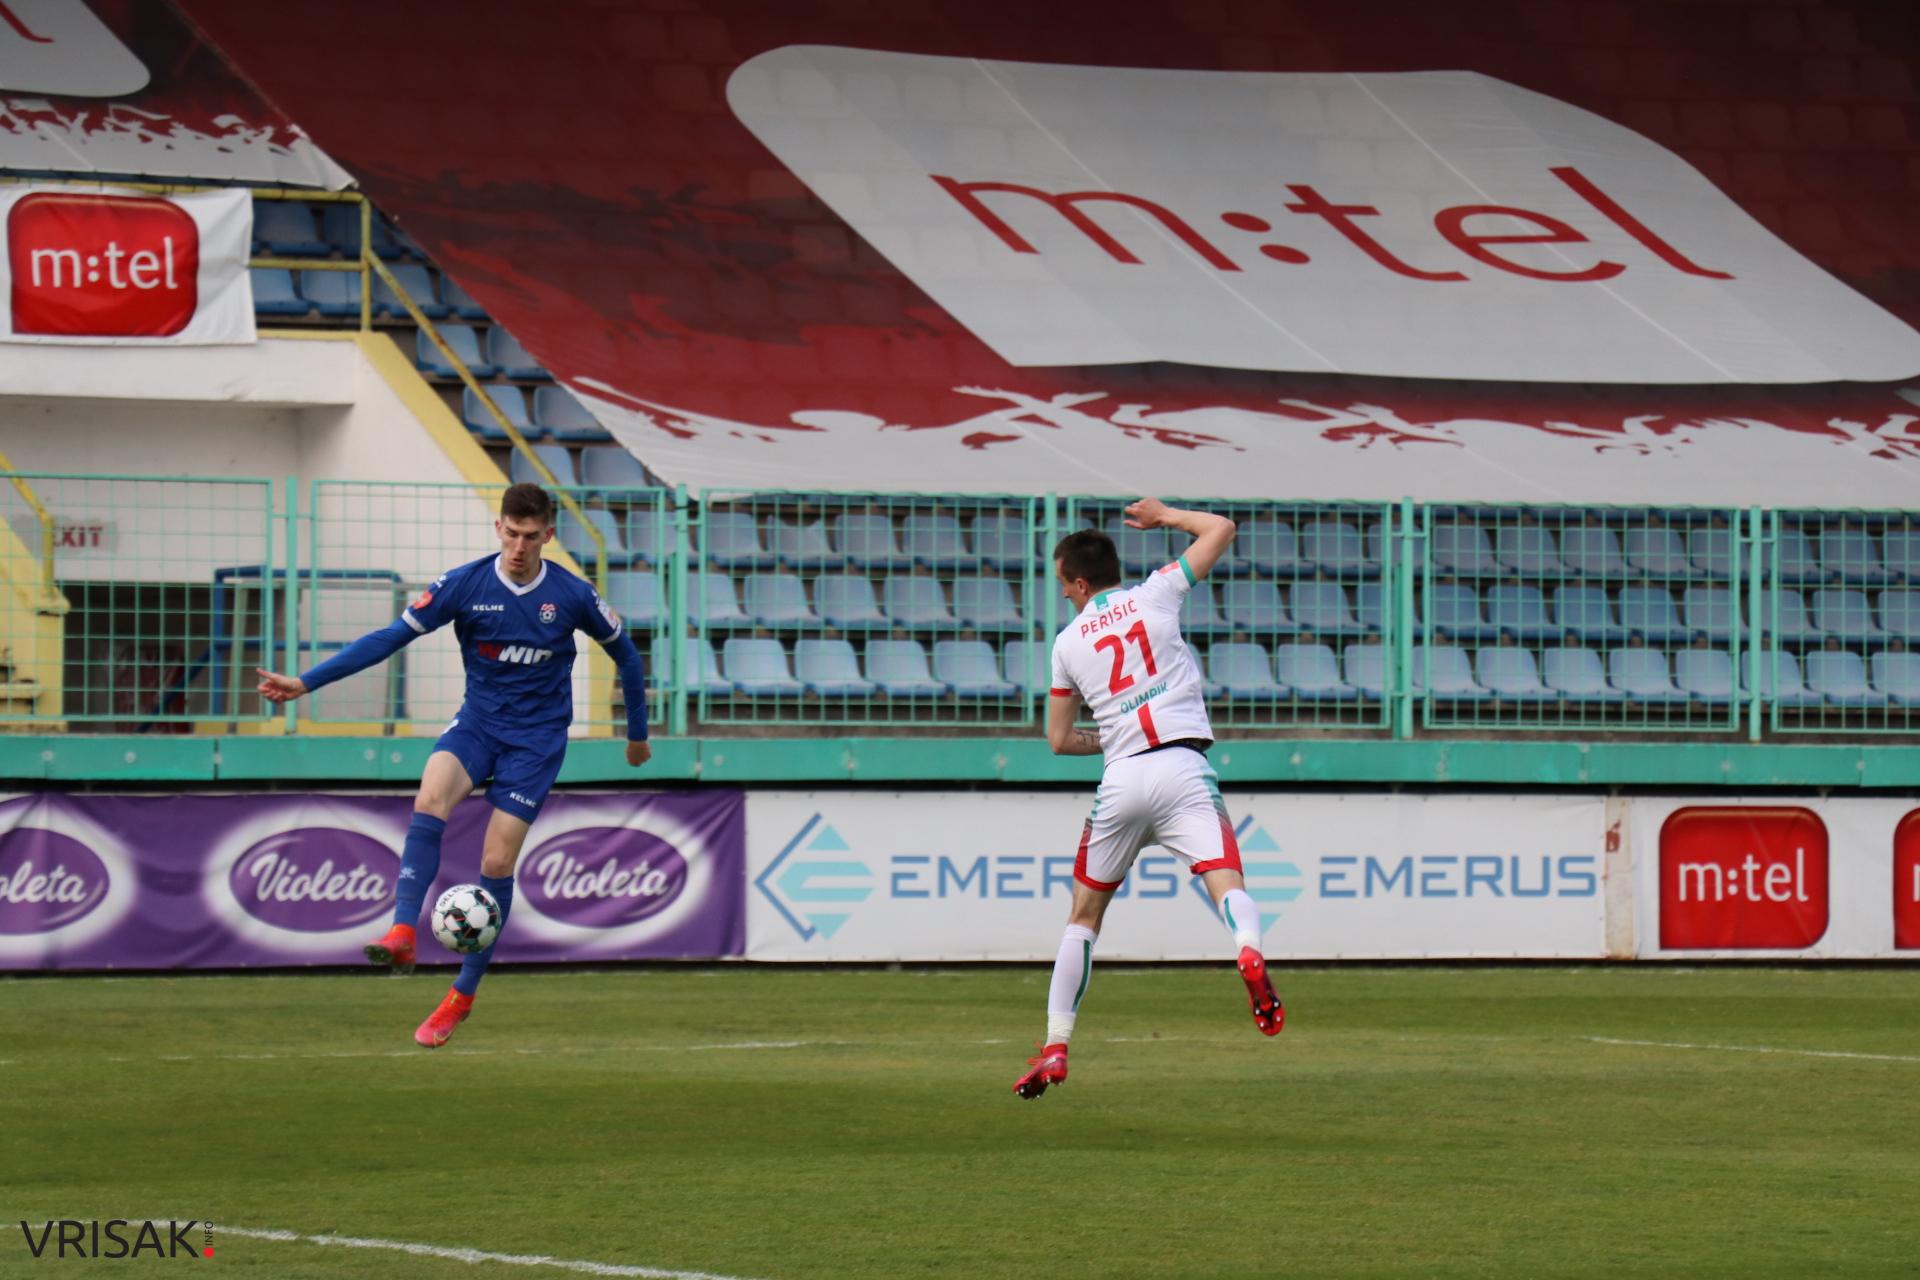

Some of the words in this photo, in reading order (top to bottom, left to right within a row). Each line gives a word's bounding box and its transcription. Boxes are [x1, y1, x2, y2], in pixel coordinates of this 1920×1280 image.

[930, 166, 1736, 282] m:tel
[31, 236, 178, 289] m:tel
[1081, 597, 1137, 639] PERIŠIĆ
[1093, 619, 1158, 697] 21
[1120, 681, 1169, 715] OLIMPIK
[509, 791, 537, 808] KELME
[250, 852, 390, 903] Violeta
[536, 851, 669, 900] Violeta
[890, 856, 1178, 899] EMERS
[1319, 856, 1597, 898] EMERUS
[1679, 848, 1809, 902] m:tel
